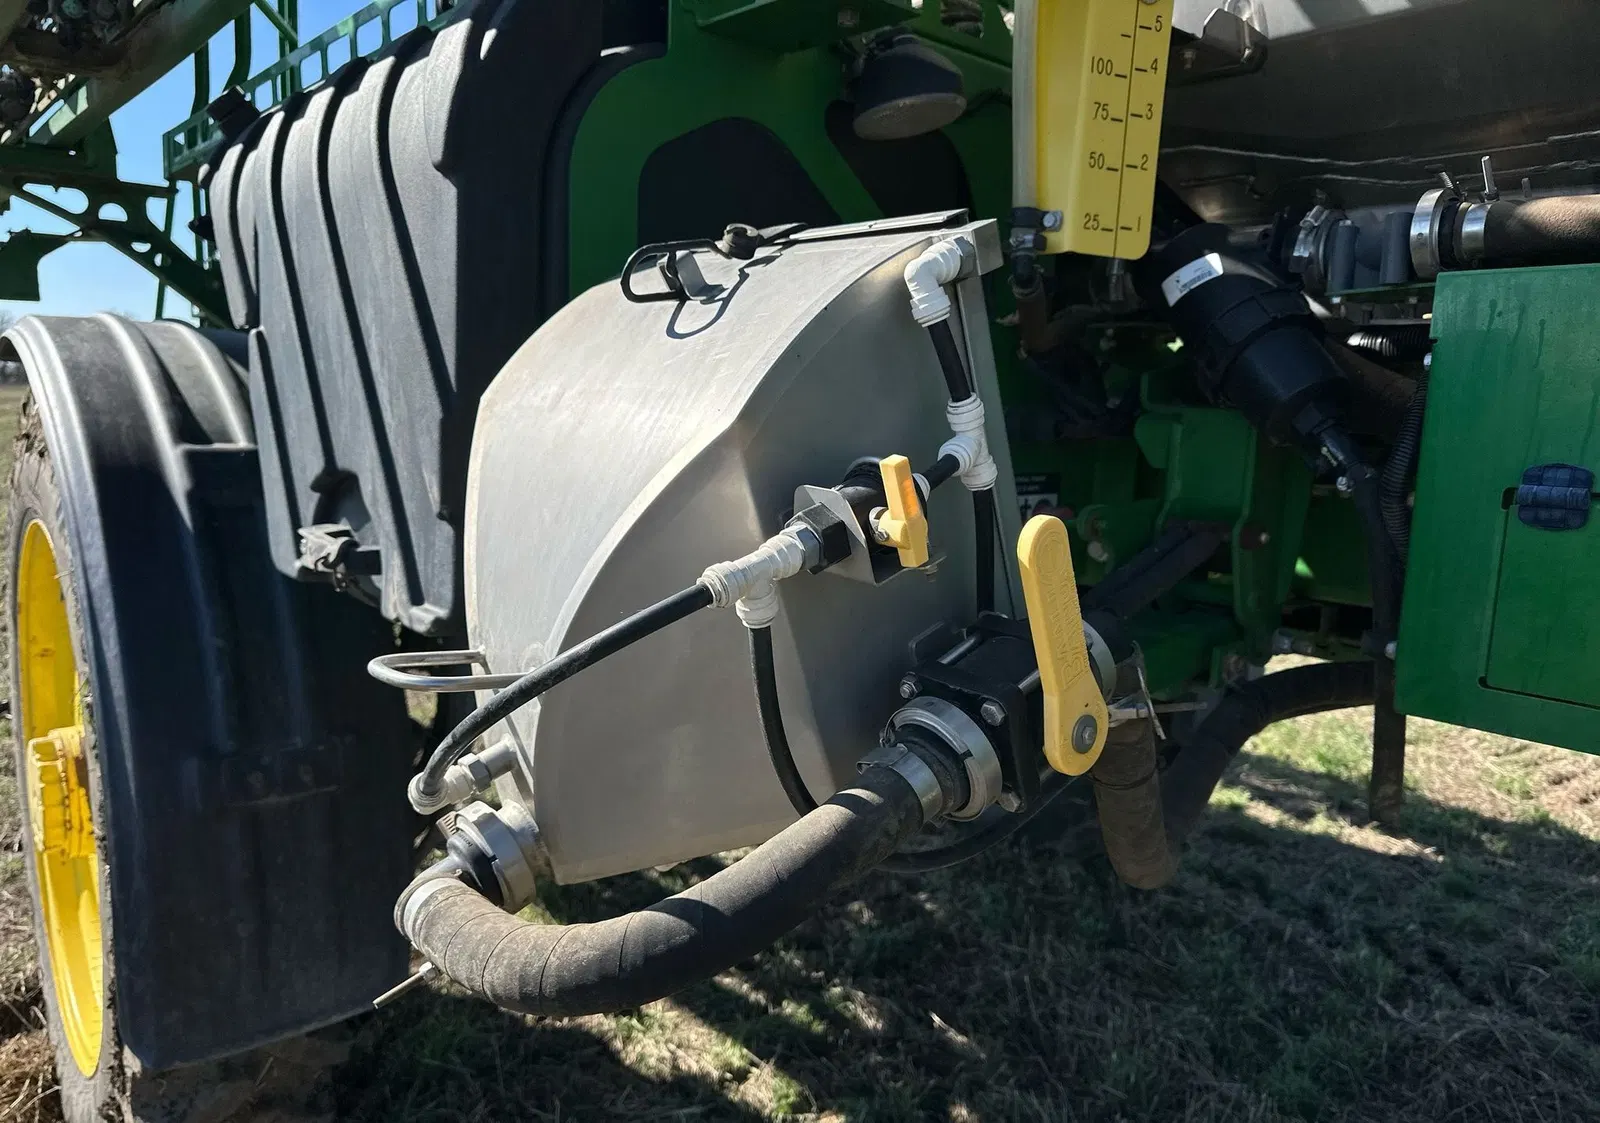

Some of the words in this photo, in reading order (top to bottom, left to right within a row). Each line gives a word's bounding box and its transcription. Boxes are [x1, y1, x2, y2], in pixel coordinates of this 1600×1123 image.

[1155, 15, 1163, 33] 5
[1091, 56, 1113, 76] 100
[1150, 58, 1158, 74] 4
[1093, 102, 1109, 120] 75
[1146, 104, 1153, 120] 3
[1088, 152, 1105, 170] 50
[1140, 154, 1148, 171] 2
[1083, 213, 1100, 231] 25
[1136, 216, 1141, 232] 1
